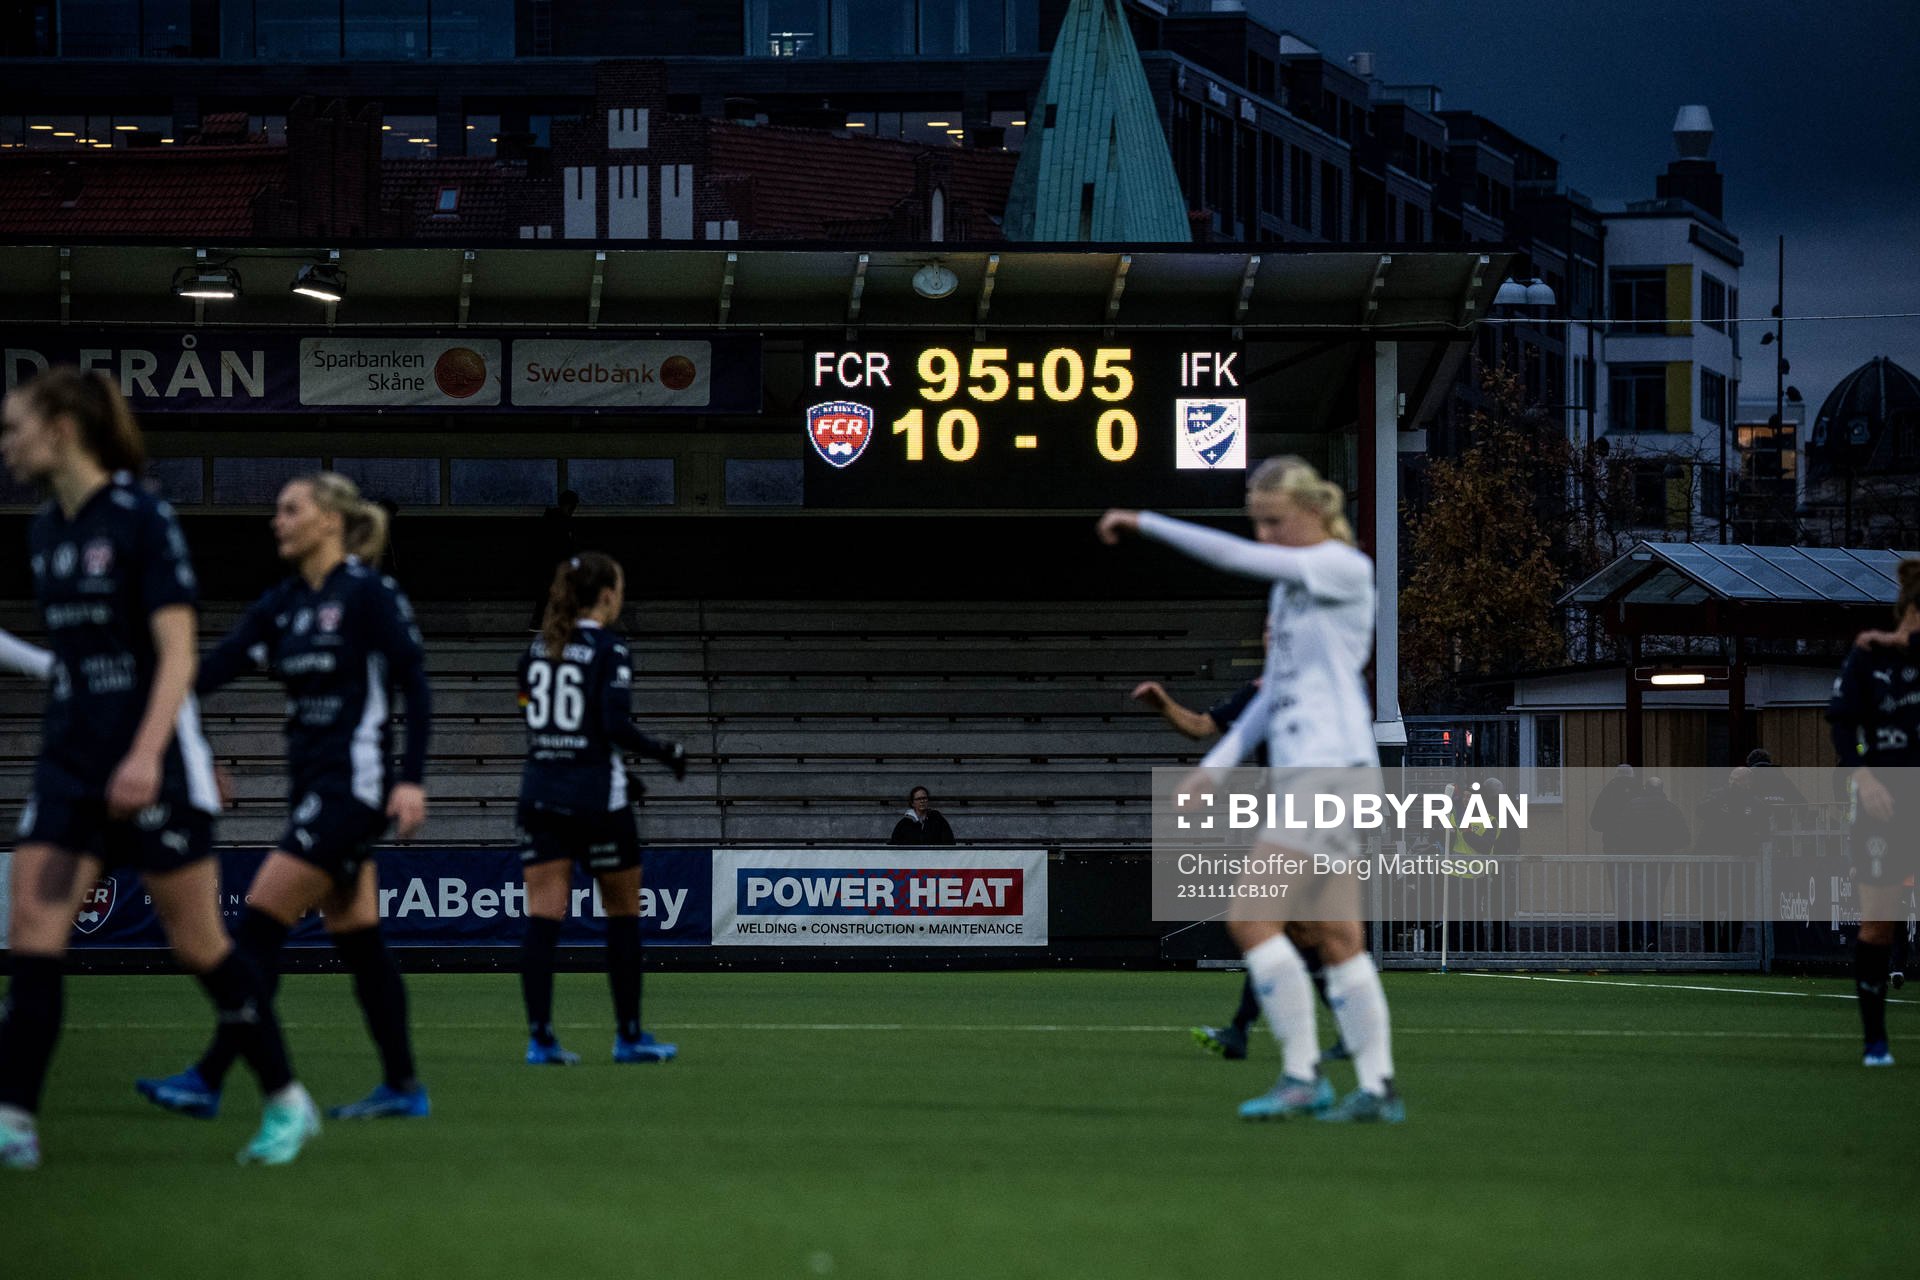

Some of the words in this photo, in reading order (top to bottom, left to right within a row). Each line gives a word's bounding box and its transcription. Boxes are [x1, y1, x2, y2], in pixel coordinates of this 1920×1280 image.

[313, 350, 425, 371] Sparbanken
[526, 362, 655, 383] Swedbank
[814, 351, 892, 388] FCR
[917, 347, 1135, 402] 95:05
[1181, 351, 1239, 387] IFK
[367, 372, 425, 391] Skåne
[816, 418, 863, 435] FCR
[892, 408, 980, 462] 10
[1095, 408, 1139, 462] 0
[526, 660, 586, 731] 36
[747, 877, 894, 907] POWER
[909, 878, 1013, 907] HEAT
[736, 923, 797, 934] WELDING
[810, 923, 915, 935] CONSTRUCTION
[928, 923, 1023, 935] MAINTENANCE
